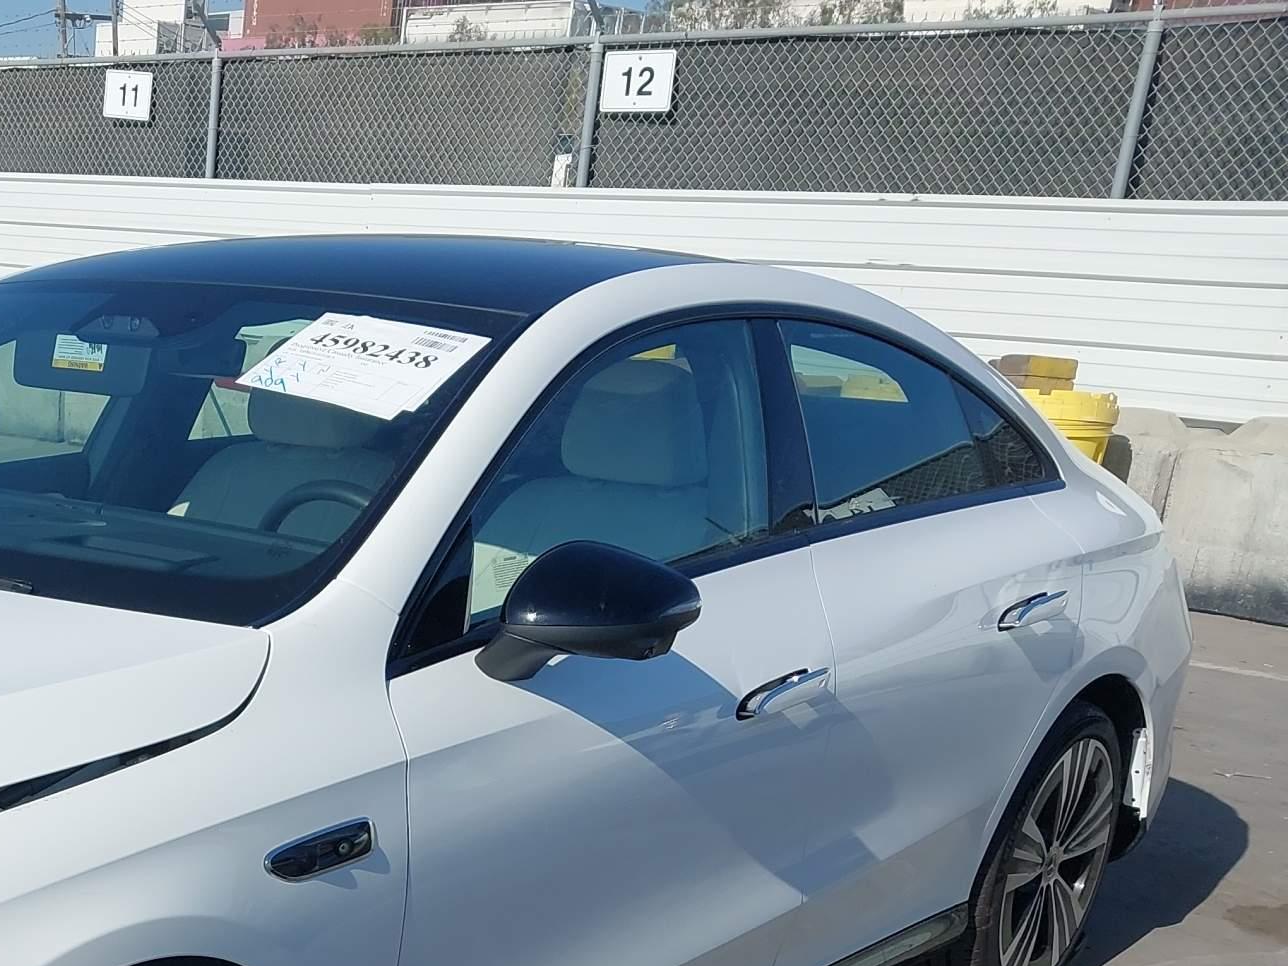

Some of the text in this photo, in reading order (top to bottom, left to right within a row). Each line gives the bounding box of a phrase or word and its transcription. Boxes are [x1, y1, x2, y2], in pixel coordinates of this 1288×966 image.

[119, 83, 138, 108] 11
[621, 66, 655, 97] 12
[309, 333, 439, 369] 45982438
